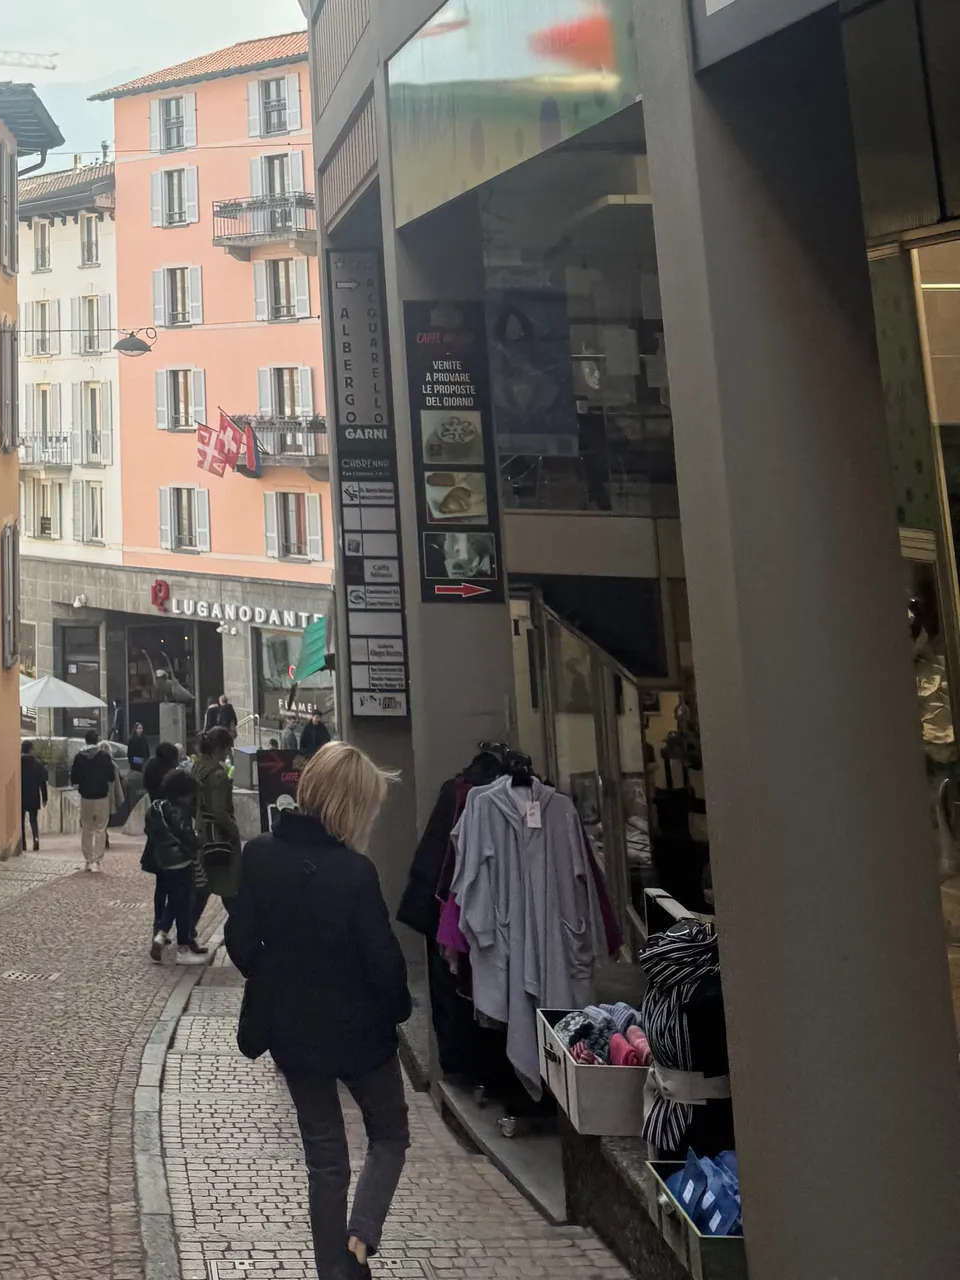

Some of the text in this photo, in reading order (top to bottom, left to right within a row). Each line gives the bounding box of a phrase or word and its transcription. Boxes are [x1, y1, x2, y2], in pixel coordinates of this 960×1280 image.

[340, 307, 357, 424] ALBERGO
[432, 360, 462, 370] VENITE
[425, 372, 470, 382] A PROVARE
[422, 384, 476, 395] LE PROPOSTE
[426, 396, 474, 407] DEL GIORNO
[345, 428, 388, 440] GARNI
